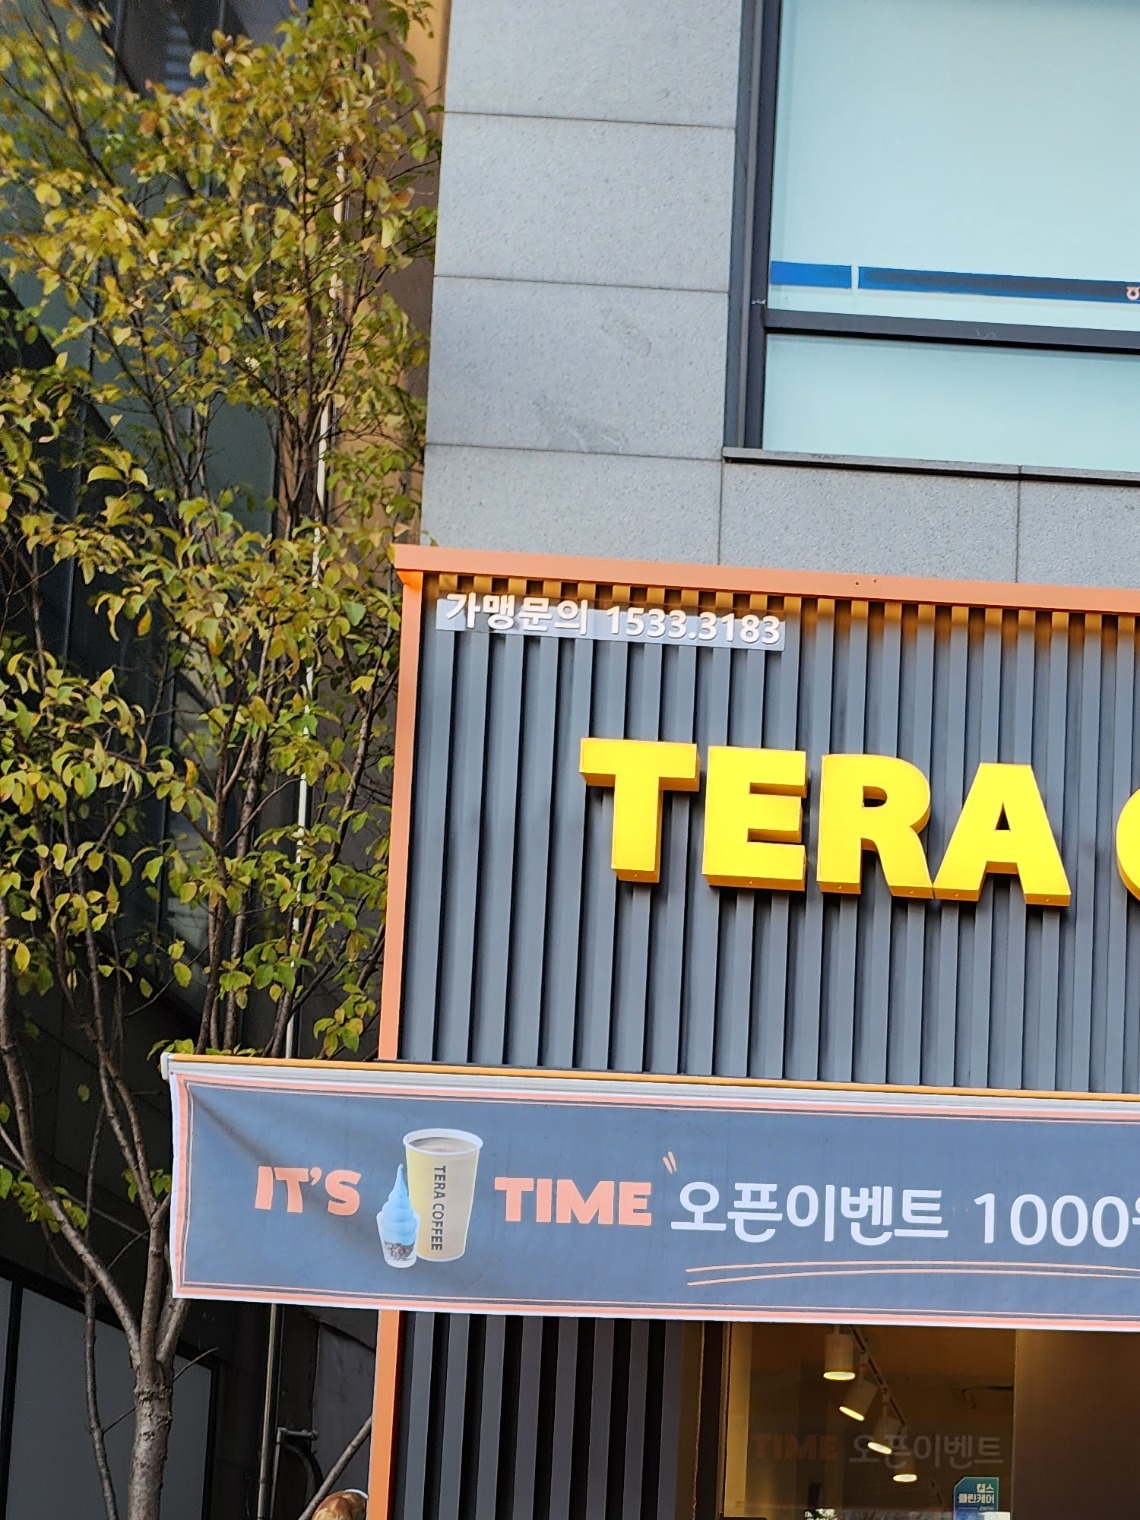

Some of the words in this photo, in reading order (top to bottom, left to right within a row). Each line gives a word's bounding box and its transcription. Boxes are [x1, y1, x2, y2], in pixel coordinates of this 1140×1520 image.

[445, 592, 589, 634] 가맹문의
[605, 606, 782, 644] 1533.3183
[579, 737, 1071, 907] TERA
[254, 1165, 362, 1216] IT'S
[433, 1165, 446, 1199] TERA
[430, 1202, 445, 1251] COFFEE
[495, 1177, 652, 1227] TIME
[670, 1181, 949, 1245] 오픈이벤트
[752, 1433, 839, 1461] TIME
